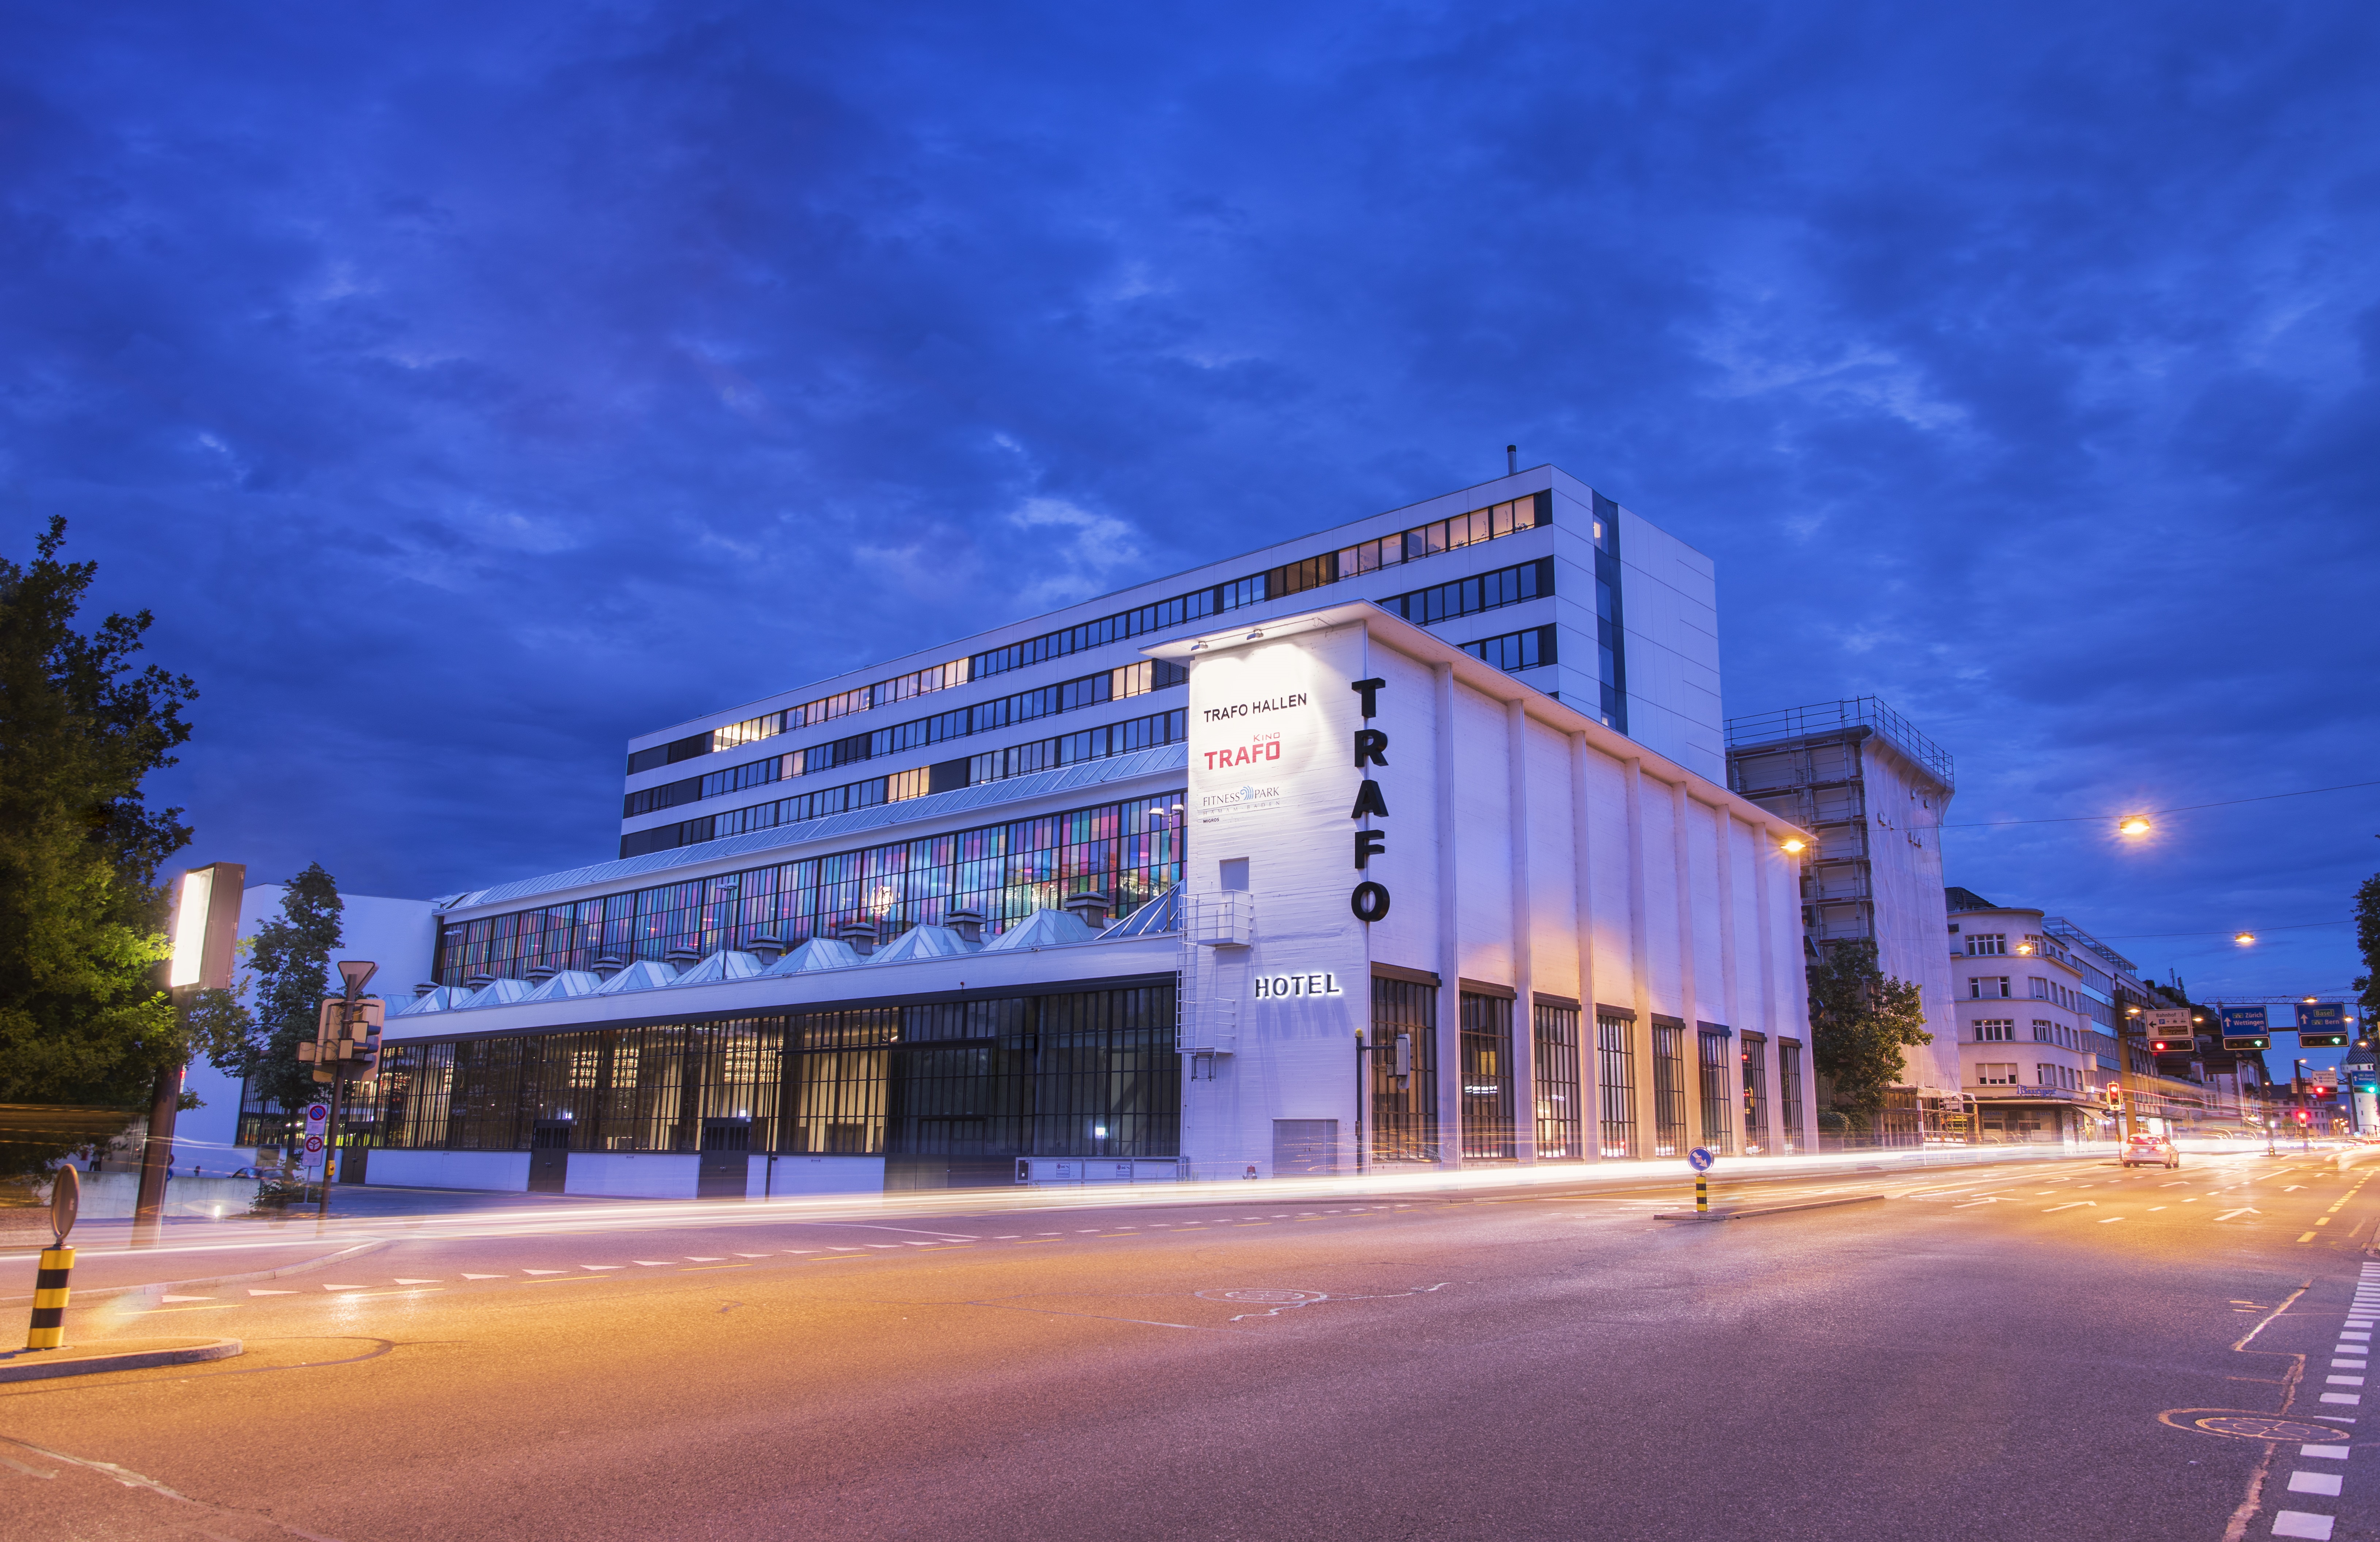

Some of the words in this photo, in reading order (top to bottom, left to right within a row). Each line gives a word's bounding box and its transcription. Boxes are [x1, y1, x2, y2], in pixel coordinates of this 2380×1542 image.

[1204, 704, 1248, 722] TRAFO
[1253, 693, 1306, 714] HALLEN
[1253, 732, 1280, 742] KINO
[1204, 741, 1280, 770] TRAFO
[1203, 792, 1240, 806] FITNESS
[1254, 787, 1279, 799] PARK
[1351, 677, 1390, 922] TRAFO
[1203, 807, 1238, 816] HAMAM
[1247, 801, 1280, 810] BADEN
[1255, 974, 1340, 998] HOTEL
[2017, 1085, 2056, 1097] Burger
